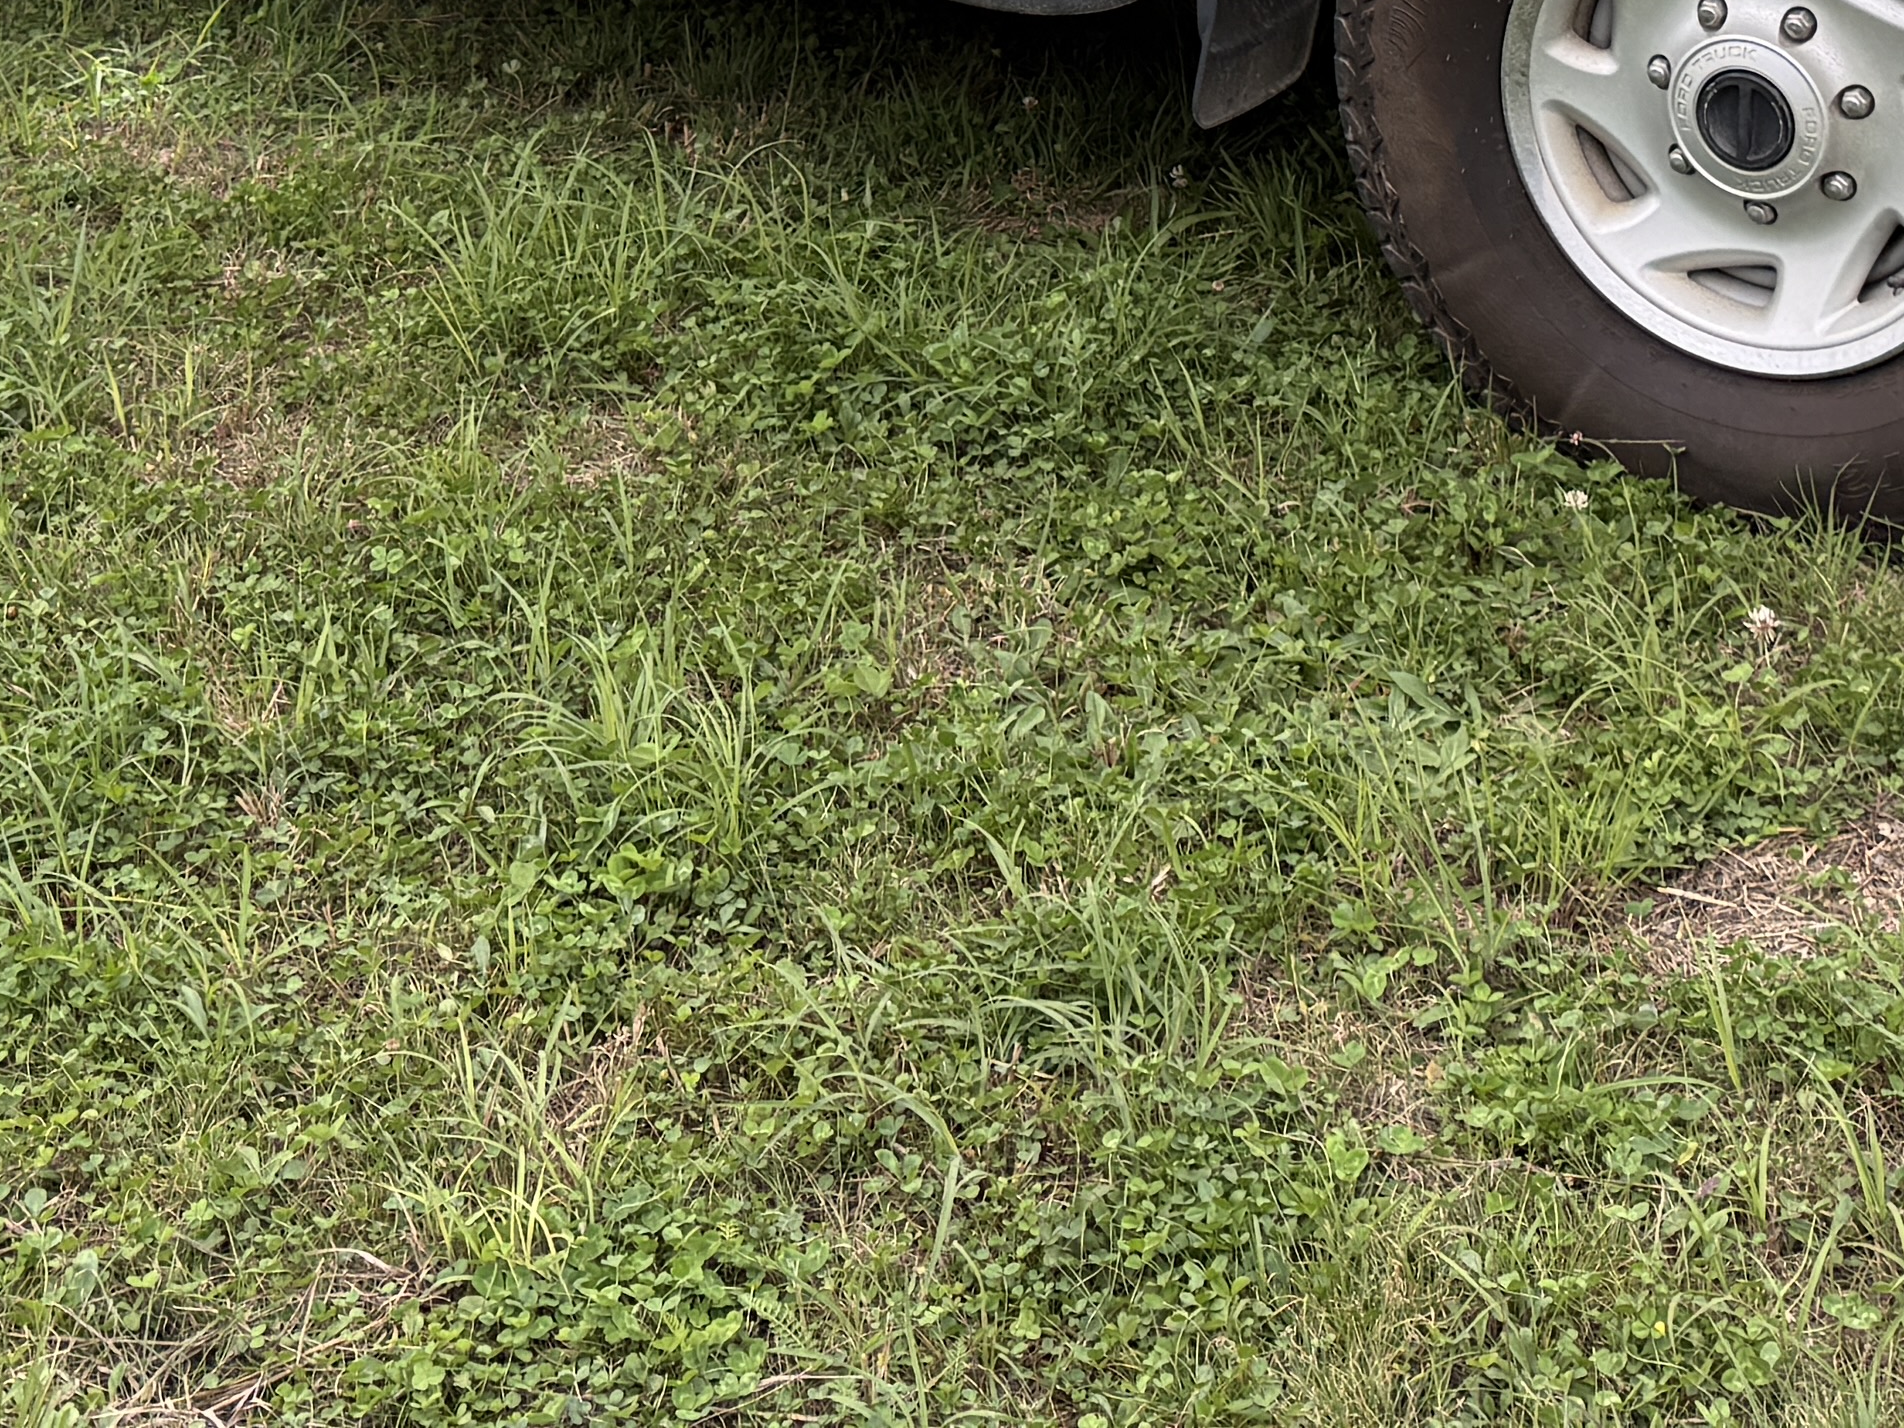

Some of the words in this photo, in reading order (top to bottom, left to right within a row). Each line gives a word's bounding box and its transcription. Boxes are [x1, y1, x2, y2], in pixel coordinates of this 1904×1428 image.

[1673, 72, 1695, 132] FORD
[1691, 44, 1758, 72] TRUCK
[1796, 107, 1819, 167] FORD
